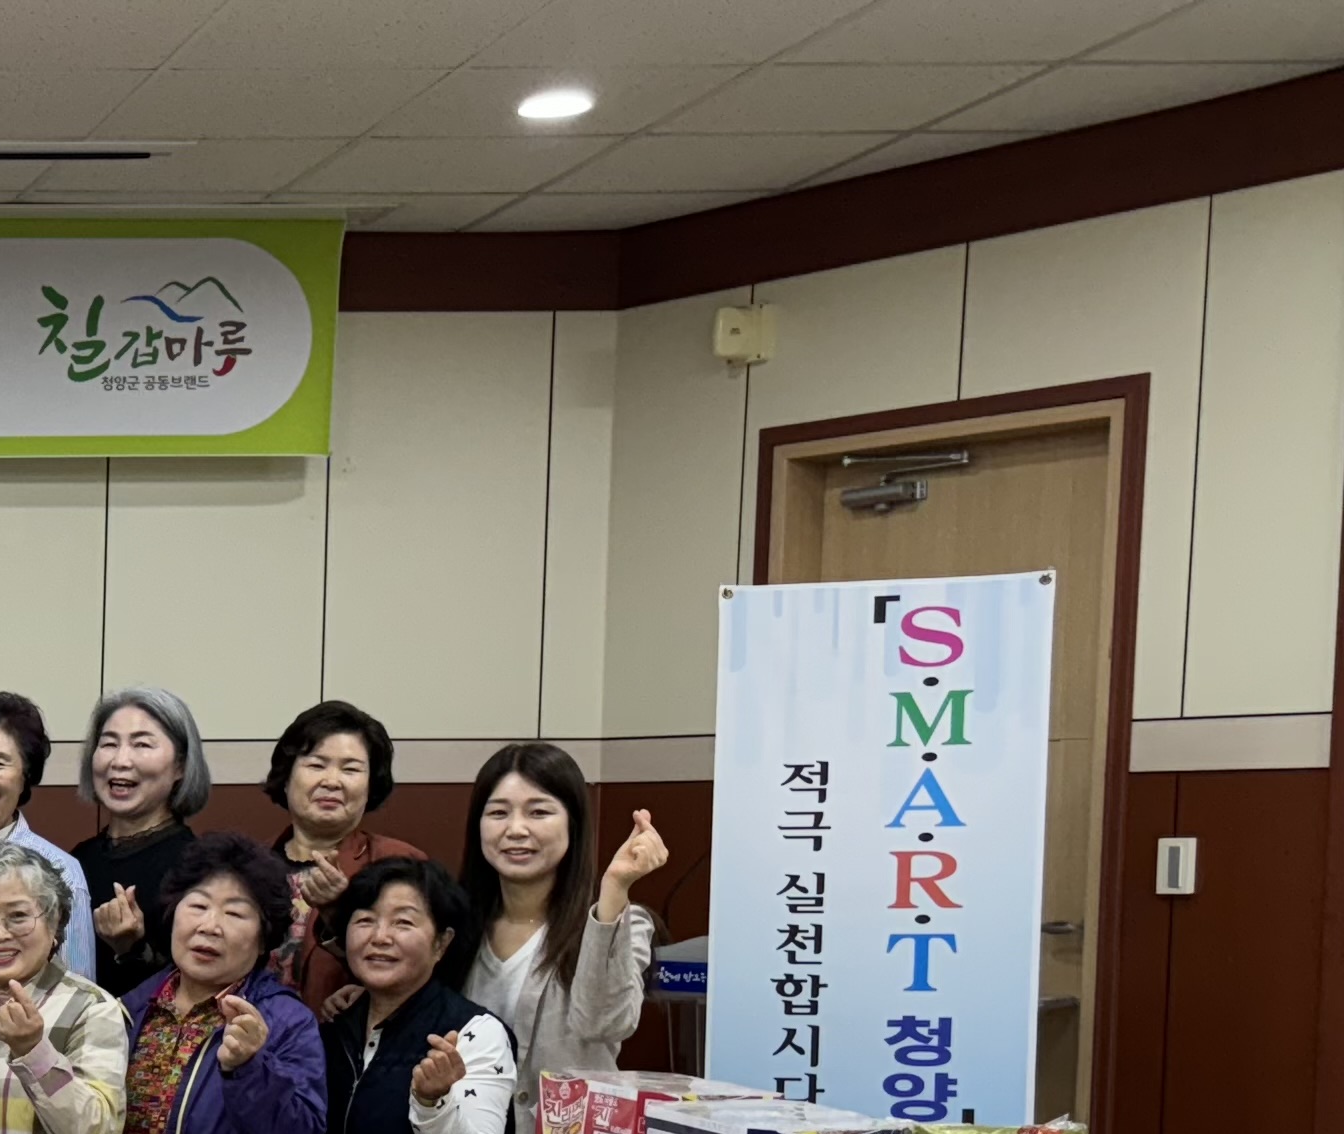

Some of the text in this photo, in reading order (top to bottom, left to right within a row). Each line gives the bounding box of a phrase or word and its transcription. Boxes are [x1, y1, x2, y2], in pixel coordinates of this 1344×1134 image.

[100, 374, 211, 392] 청양군 공동브랜드
[770, 760, 832, 1106] 적극 실천합시다
